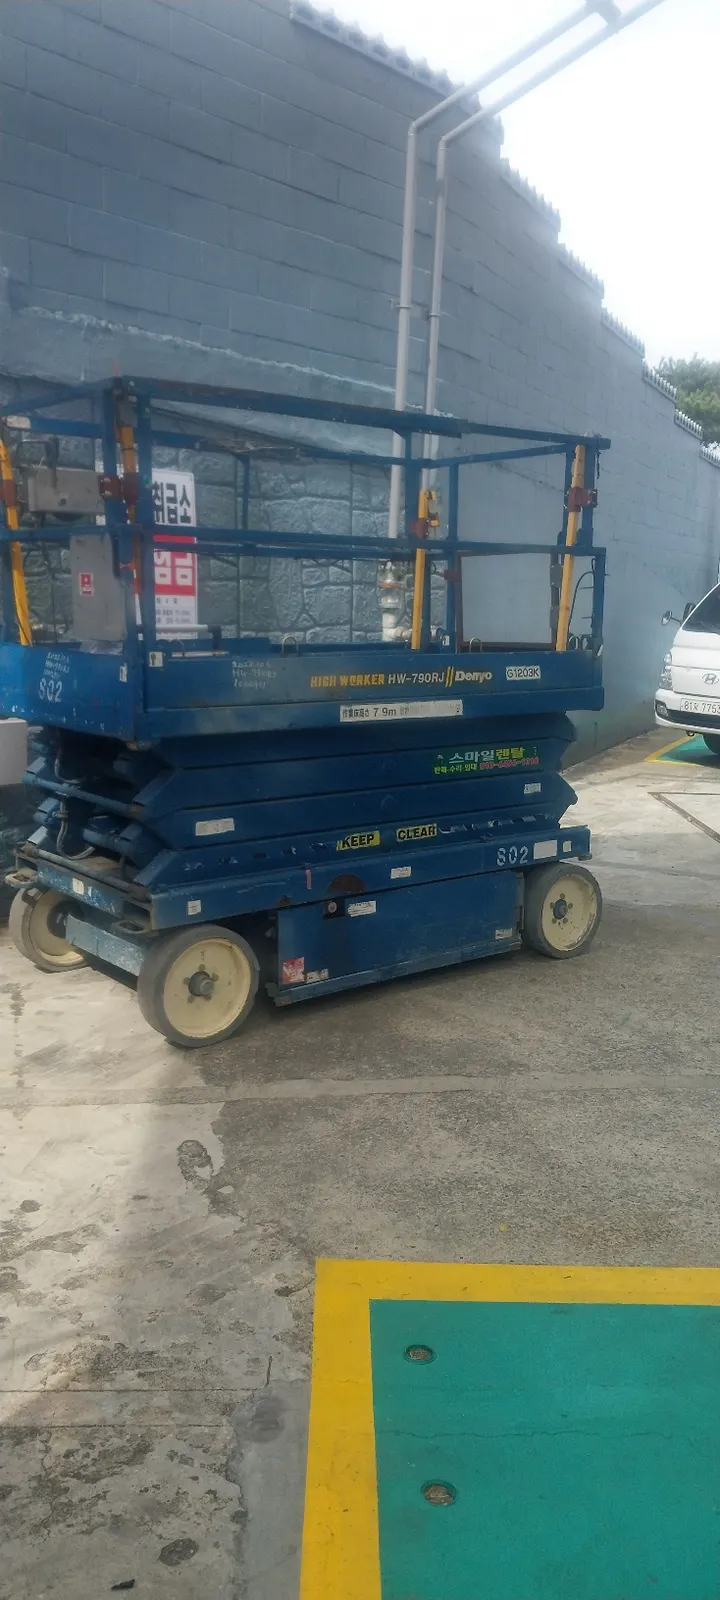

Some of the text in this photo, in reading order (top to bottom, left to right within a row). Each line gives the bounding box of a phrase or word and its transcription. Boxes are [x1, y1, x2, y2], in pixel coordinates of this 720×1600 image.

[310, 668, 540, 688] HIGH WORKER HW-790RJ Denyo G1203K
[39, 677, 63, 703] 802
[448, 746, 525, 764] 스마일렌탈
[342, 825, 436, 849] KEEP CLEAR
[496, 845, 530, 867] 802
